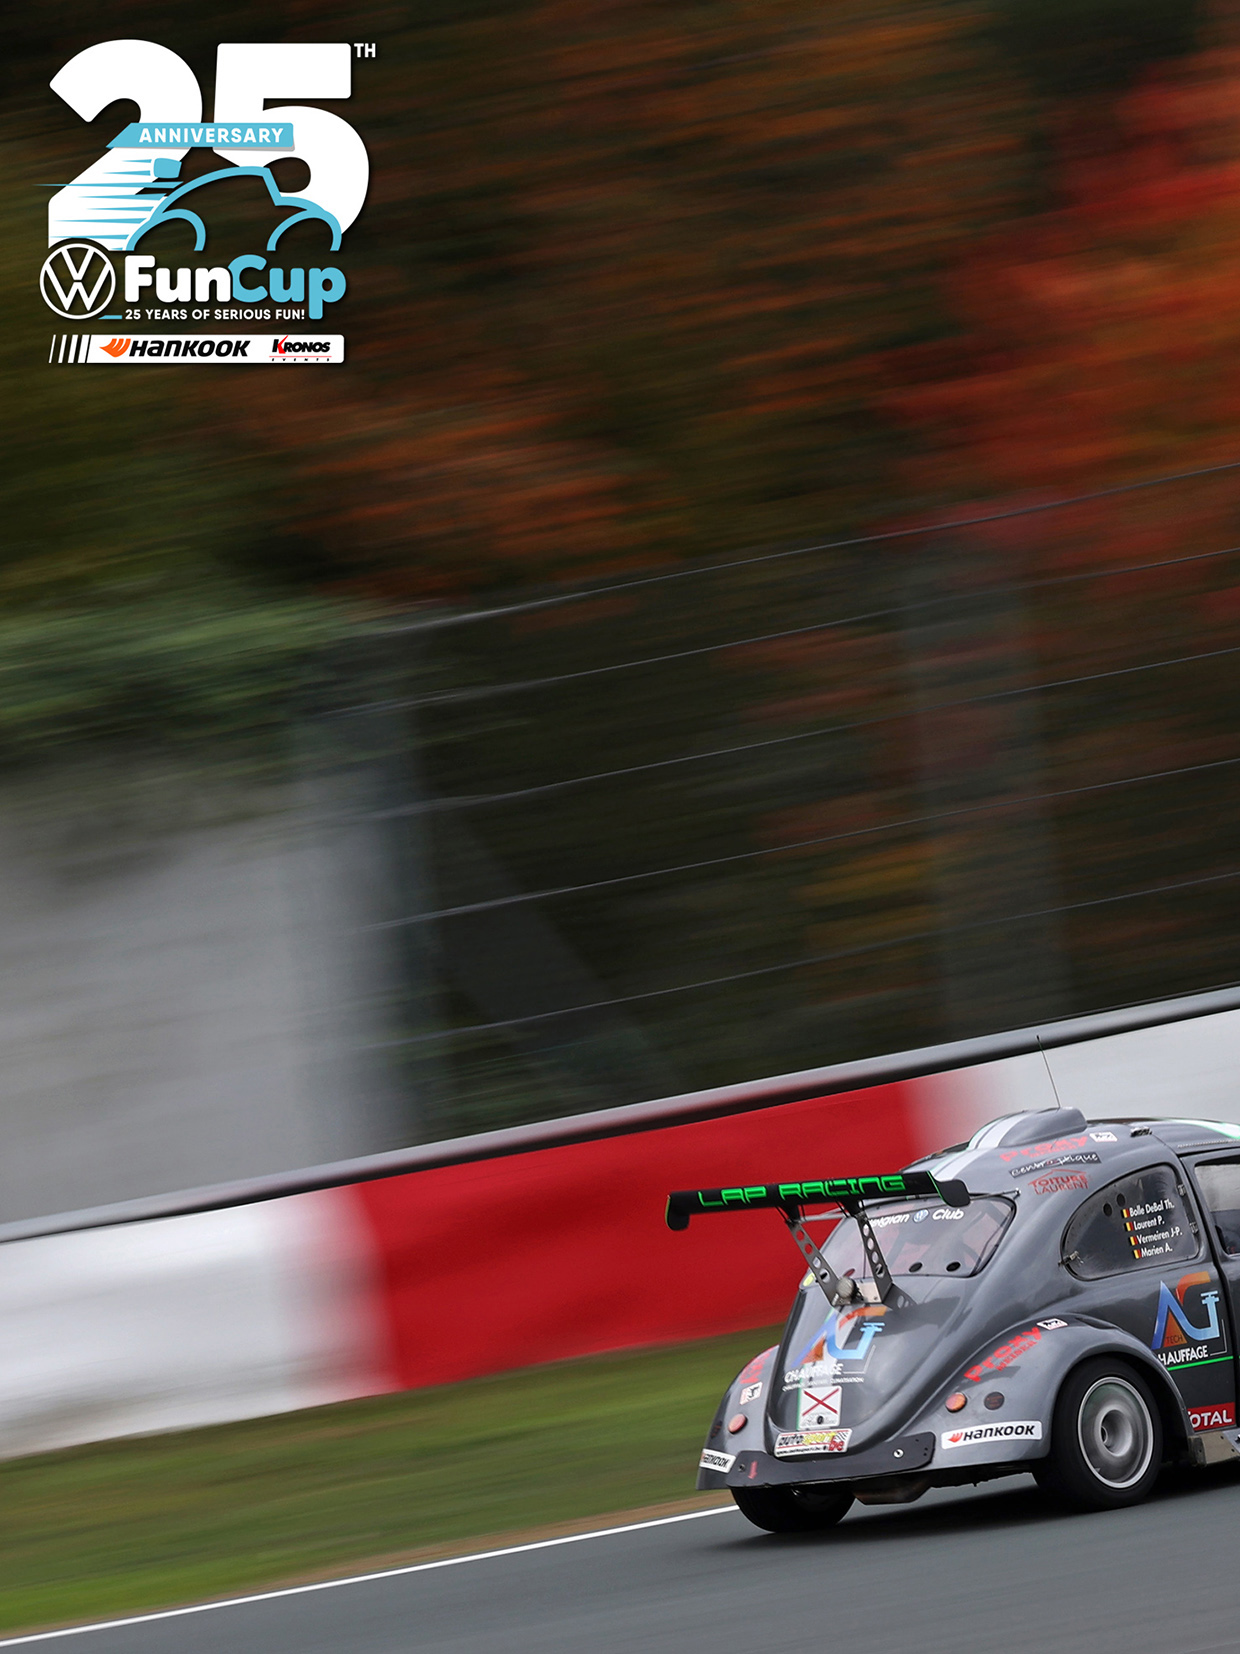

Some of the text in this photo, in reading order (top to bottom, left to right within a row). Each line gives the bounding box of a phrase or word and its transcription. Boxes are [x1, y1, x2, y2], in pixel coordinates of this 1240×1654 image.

[698, 1174, 907, 1207] LAP RACING
[1034, 1182, 1089, 1195] LAURENT
[932, 1208, 964, 1220] Club
[1133, 1215, 1165, 1230] Laurent P.
[1165, 1242, 1173, 1252] A.
[1166, 1334, 1183, 1344] TECH
[1157, 1345, 1208, 1366] HAUFFAGE
